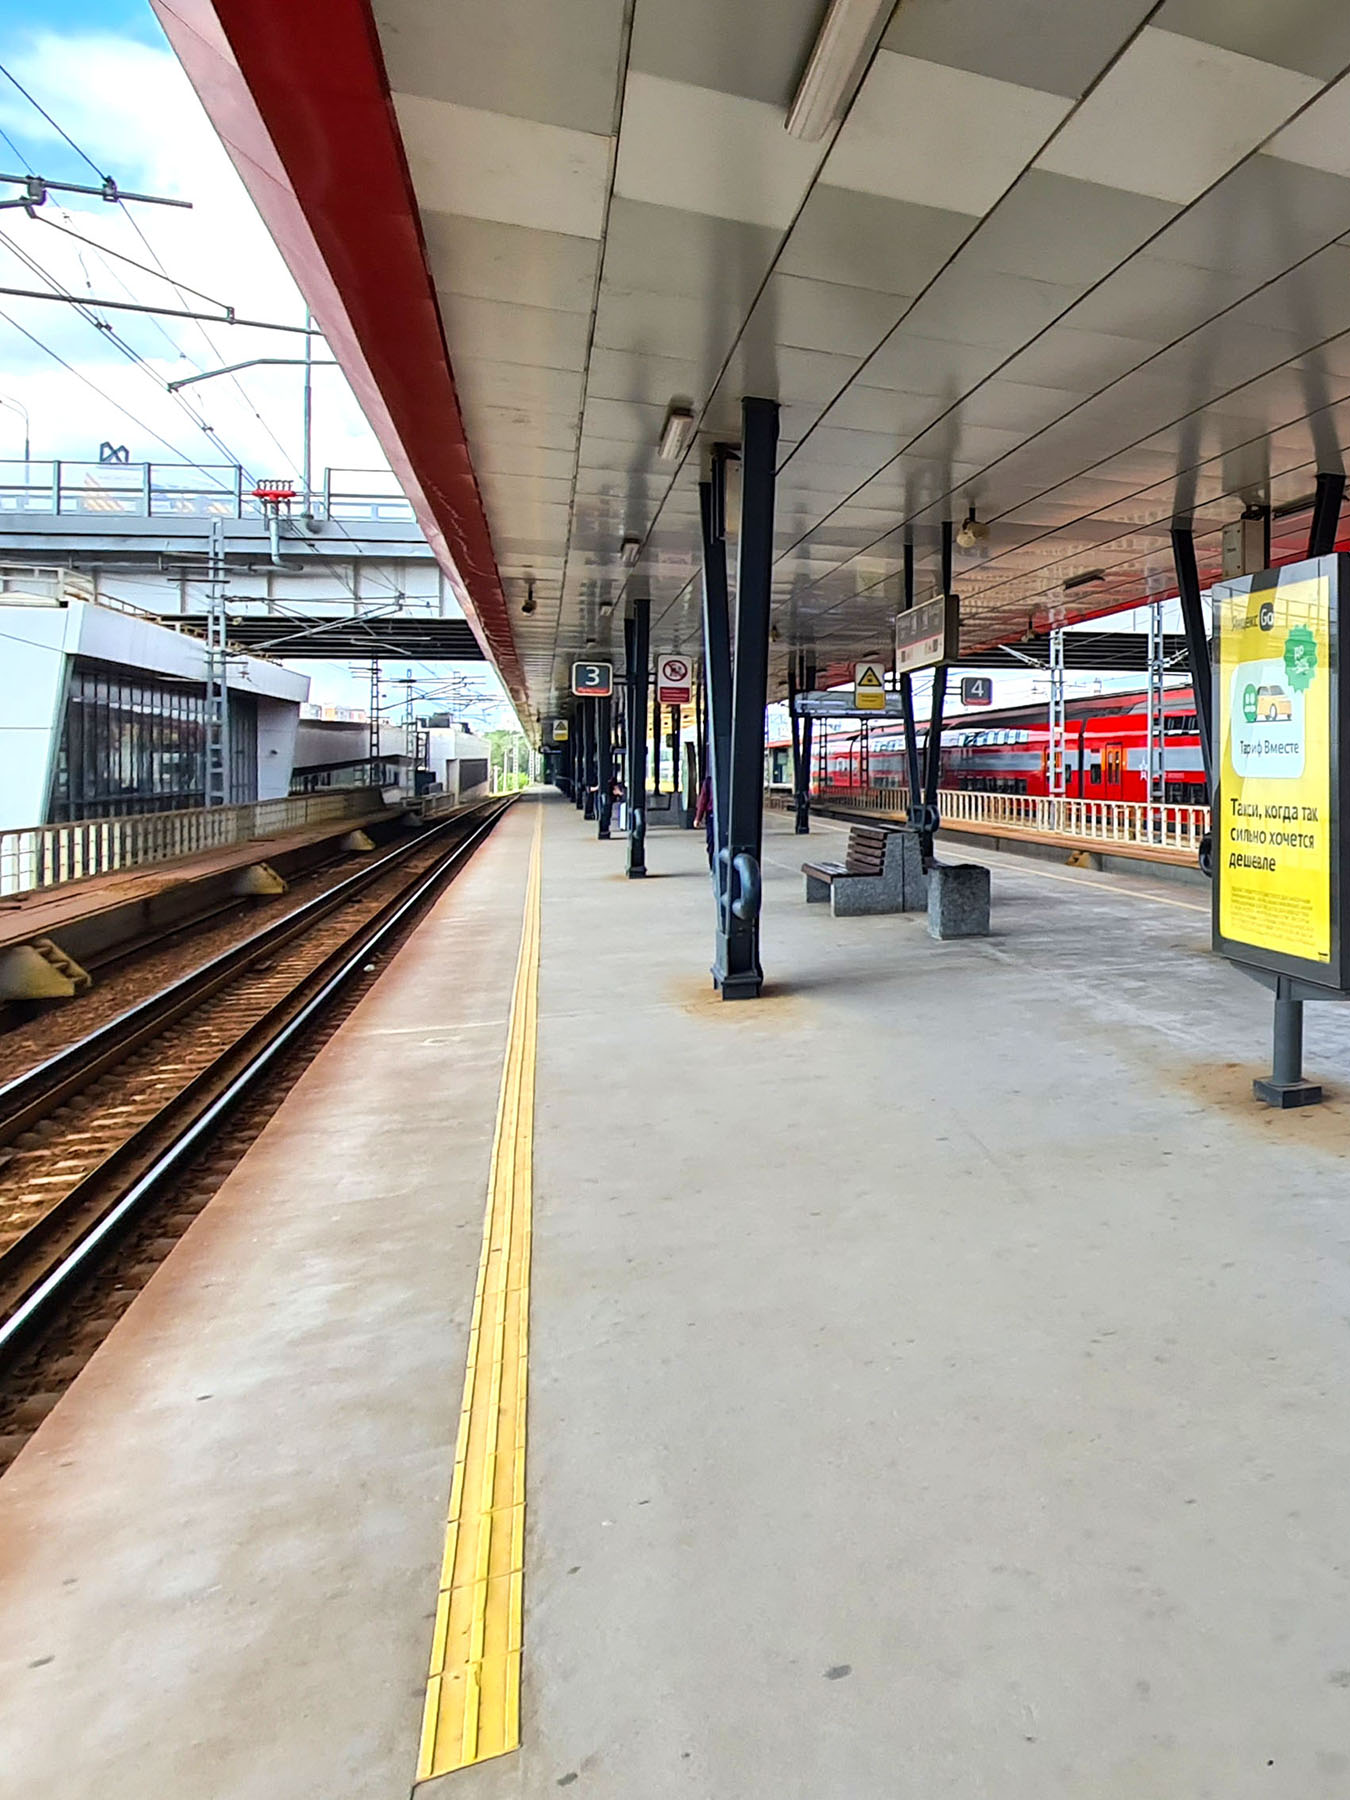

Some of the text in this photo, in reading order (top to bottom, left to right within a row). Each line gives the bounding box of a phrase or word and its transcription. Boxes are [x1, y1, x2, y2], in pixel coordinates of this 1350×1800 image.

[1260, 608, 1274, 626] Go
[585, 666, 600, 686] 3
[971, 680, 984, 697] 4
[1240, 740, 1299, 757] Тариф Вместе
[1230, 798, 1318, 823] Такси, когда так
[1230, 827, 1315, 849] сильно хочется
[1229, 852, 1276, 872] дешевле
